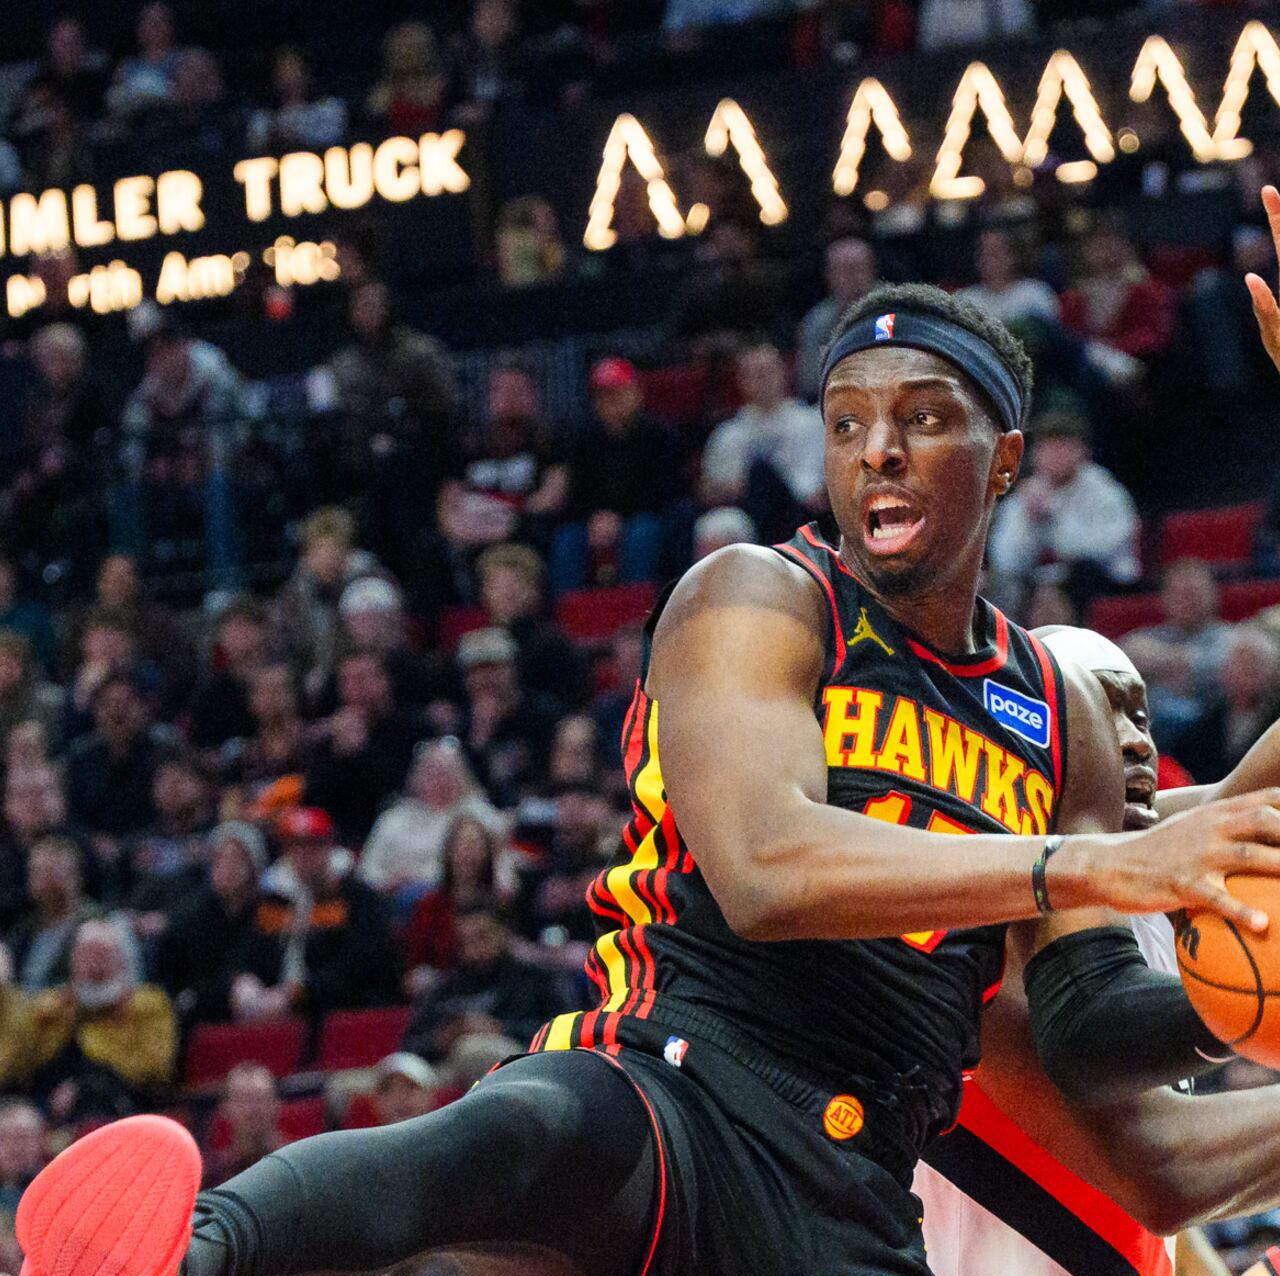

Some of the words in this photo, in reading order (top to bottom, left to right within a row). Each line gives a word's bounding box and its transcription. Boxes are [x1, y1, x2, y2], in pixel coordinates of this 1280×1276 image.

[233, 128, 471, 222] TRUCK
[990, 693, 1044, 730] paze
[822, 685, 1055, 836] HAWKS
[830, 1104, 858, 1132] ATL
